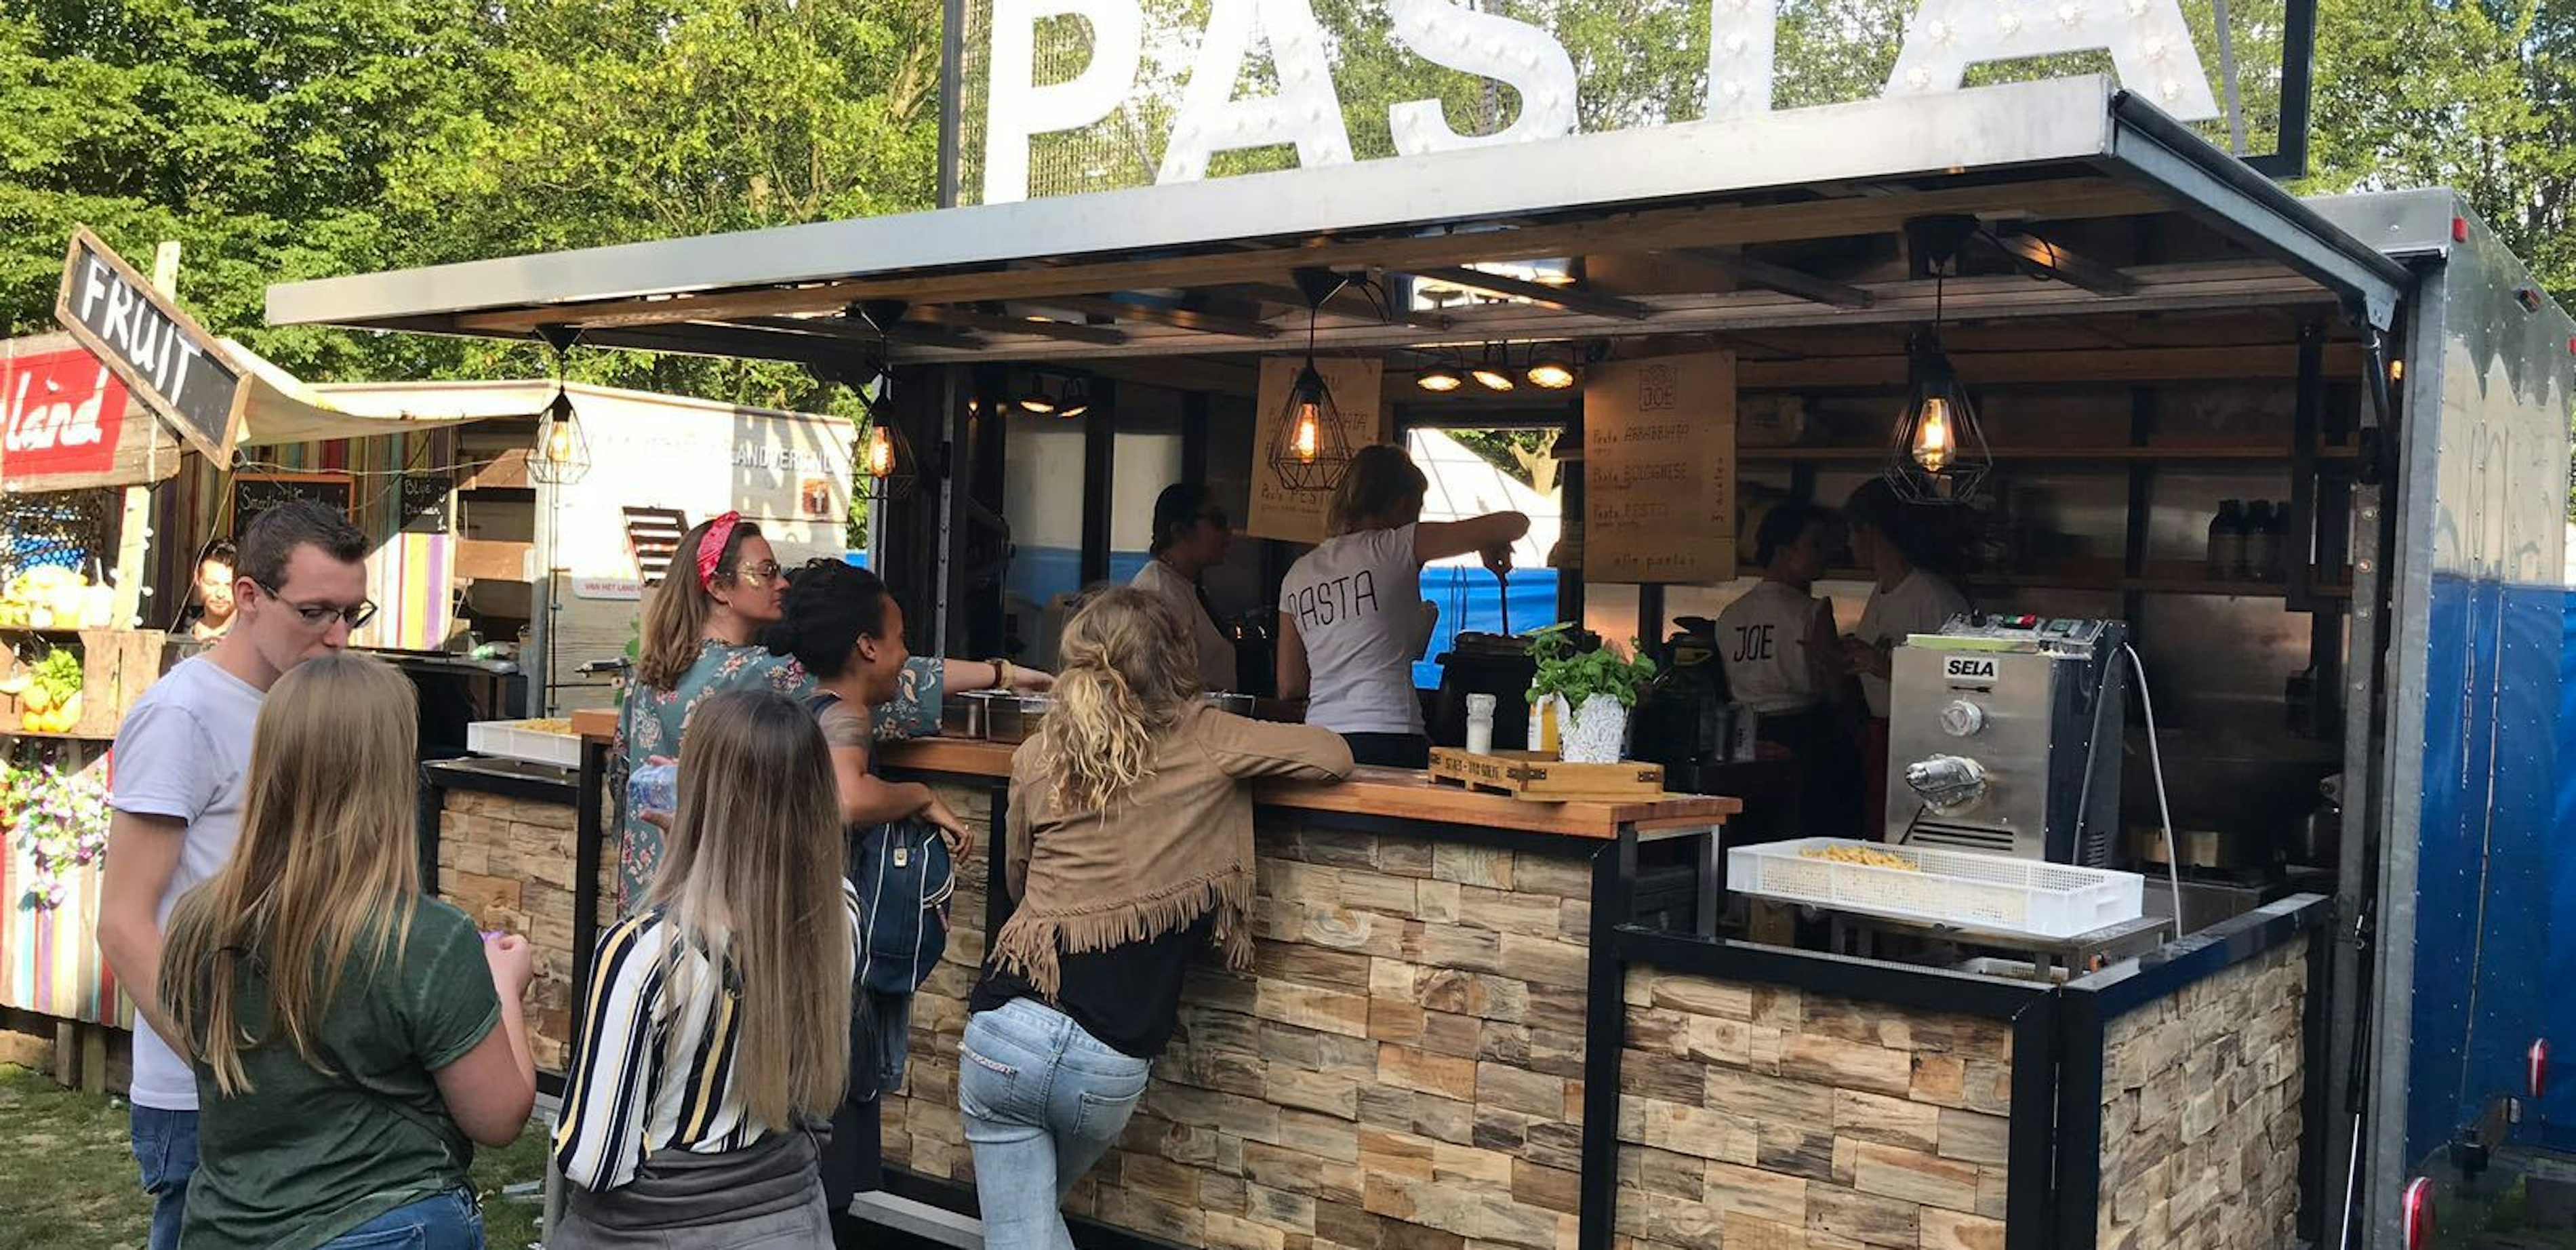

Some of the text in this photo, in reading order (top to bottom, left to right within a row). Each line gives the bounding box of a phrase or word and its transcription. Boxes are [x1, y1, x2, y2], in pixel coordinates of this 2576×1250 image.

[81, 252, 203, 407] FRUIT
[0, 365, 110, 451] land
[1643, 385, 1673, 407] JOE
[1734, 624, 1775, 662] JOE
[1948, 660, 1994, 677] SELA
